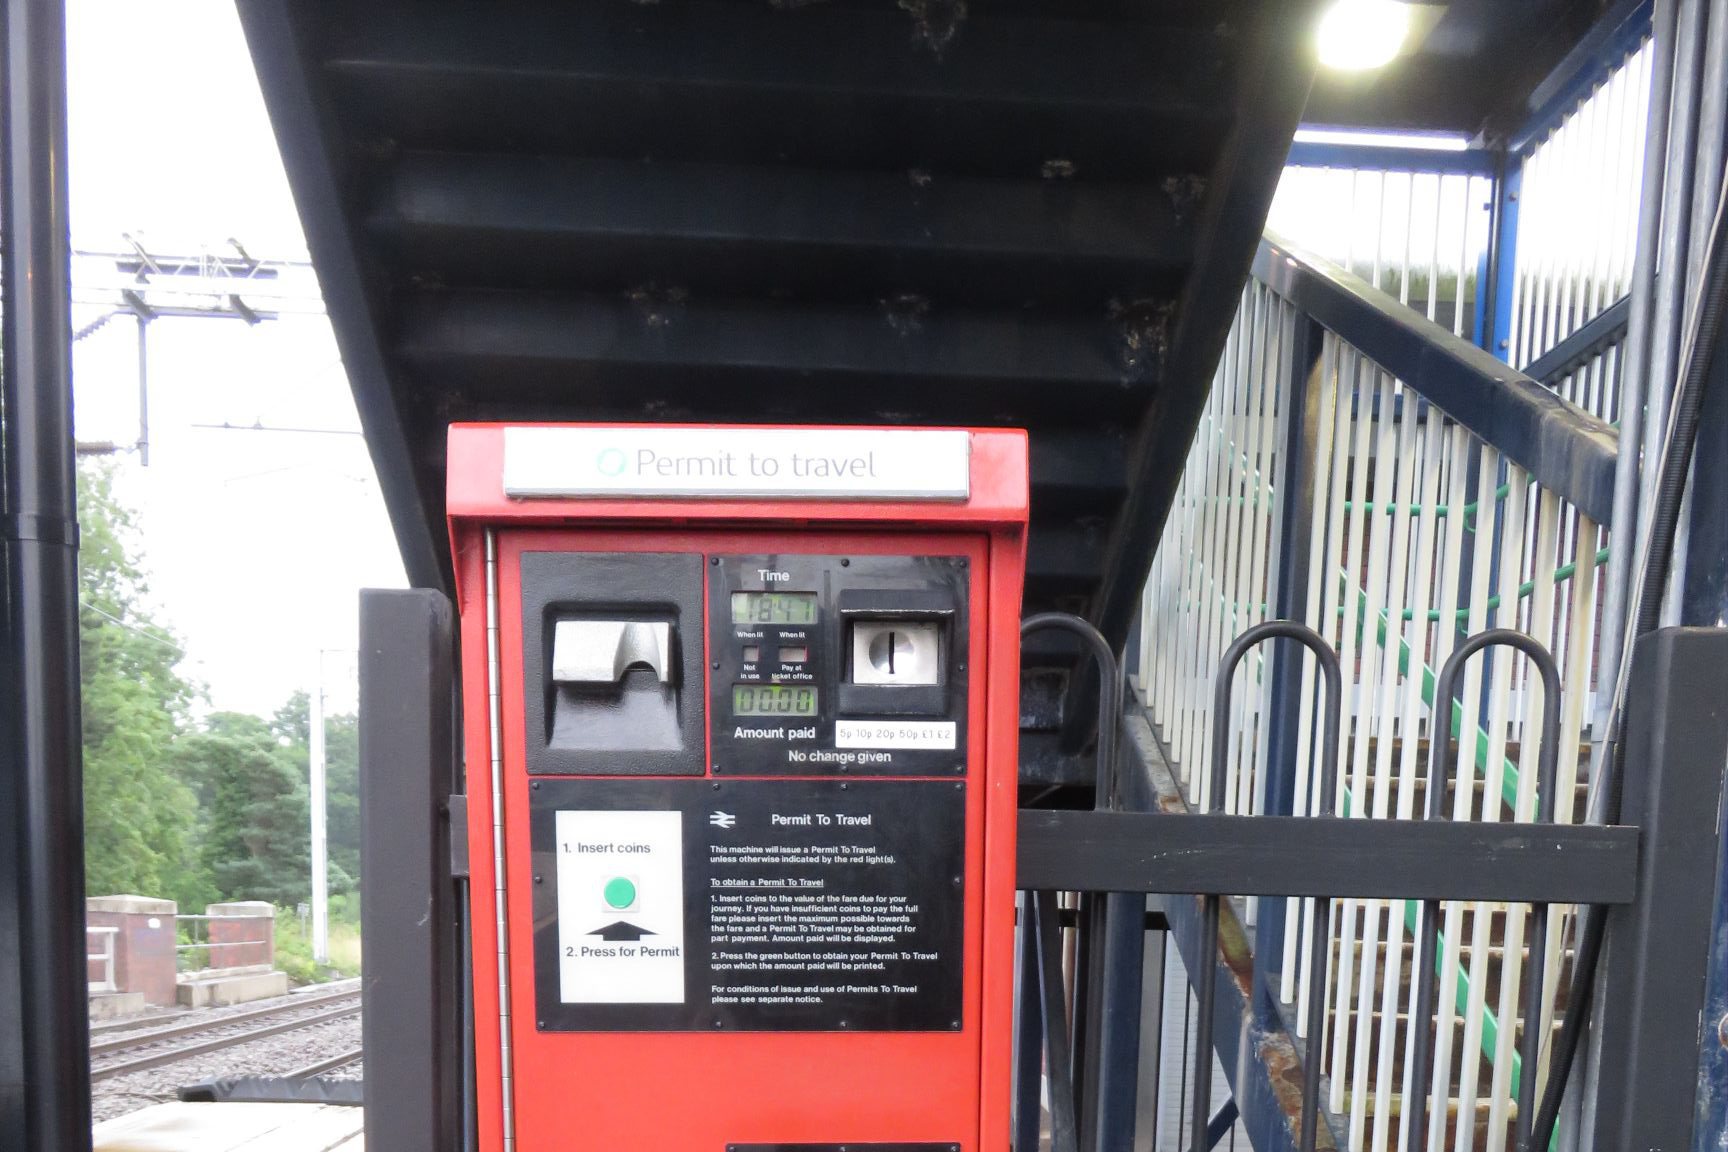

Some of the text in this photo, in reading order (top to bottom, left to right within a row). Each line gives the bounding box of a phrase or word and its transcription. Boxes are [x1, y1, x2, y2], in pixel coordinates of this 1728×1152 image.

[637, 449, 876, 477] Permit to travel
[758, 569, 790, 582] Time
[781, 664, 794, 673] Pay
[734, 727, 815, 741] Amount paid
[840, 728, 951, 740] 5p 10p 20p 50p £1 £2
[789, 750, 892, 765] No change given
[772, 814, 871, 825] Permit To Travel
[563, 842, 650, 854] 1. Insert coins
[822, 856, 832, 865] by
[866, 856, 896, 865] light(s).
[711, 879, 721, 887] To
[722, 879, 749, 887] obtain
[758, 879, 785, 887] Permit
[788, 879, 797, 887] To
[800, 879, 824, 887] Travel
[889, 896, 907, 904] your
[711, 906, 744, 914] journey.
[754, 906, 769, 914] you
[873, 906, 888, 914] pay
[729, 915, 756, 924] please
[841, 915, 875, 924] possible
[835, 926, 852, 934] may
[711, 935, 728, 944] part
[731, 935, 770, 944] payment.
[806, 935, 824, 944] paid
[854, 935, 895, 944] displayed.
[566, 946, 680, 957] 2. Press for Permit
[712, 952, 937, 962] 2. Press the green button to obtain your Permit To Travel
[711, 962, 886, 972] upon which the amount paid will be printed.
[712, 985, 724, 993] For
[727, 985, 769, 993] conditions
[771, 985, 778, 993] of
[781, 985, 801, 993] issue
[804, 985, 818, 993] and
[837, 985, 845, 993] of
[847, 985, 878, 993] Permits
[881, 985, 890, 993] To
[893, 985, 917, 993] Travel
[712, 996, 738, 1005] please
[758, 996, 793, 1005] separate
